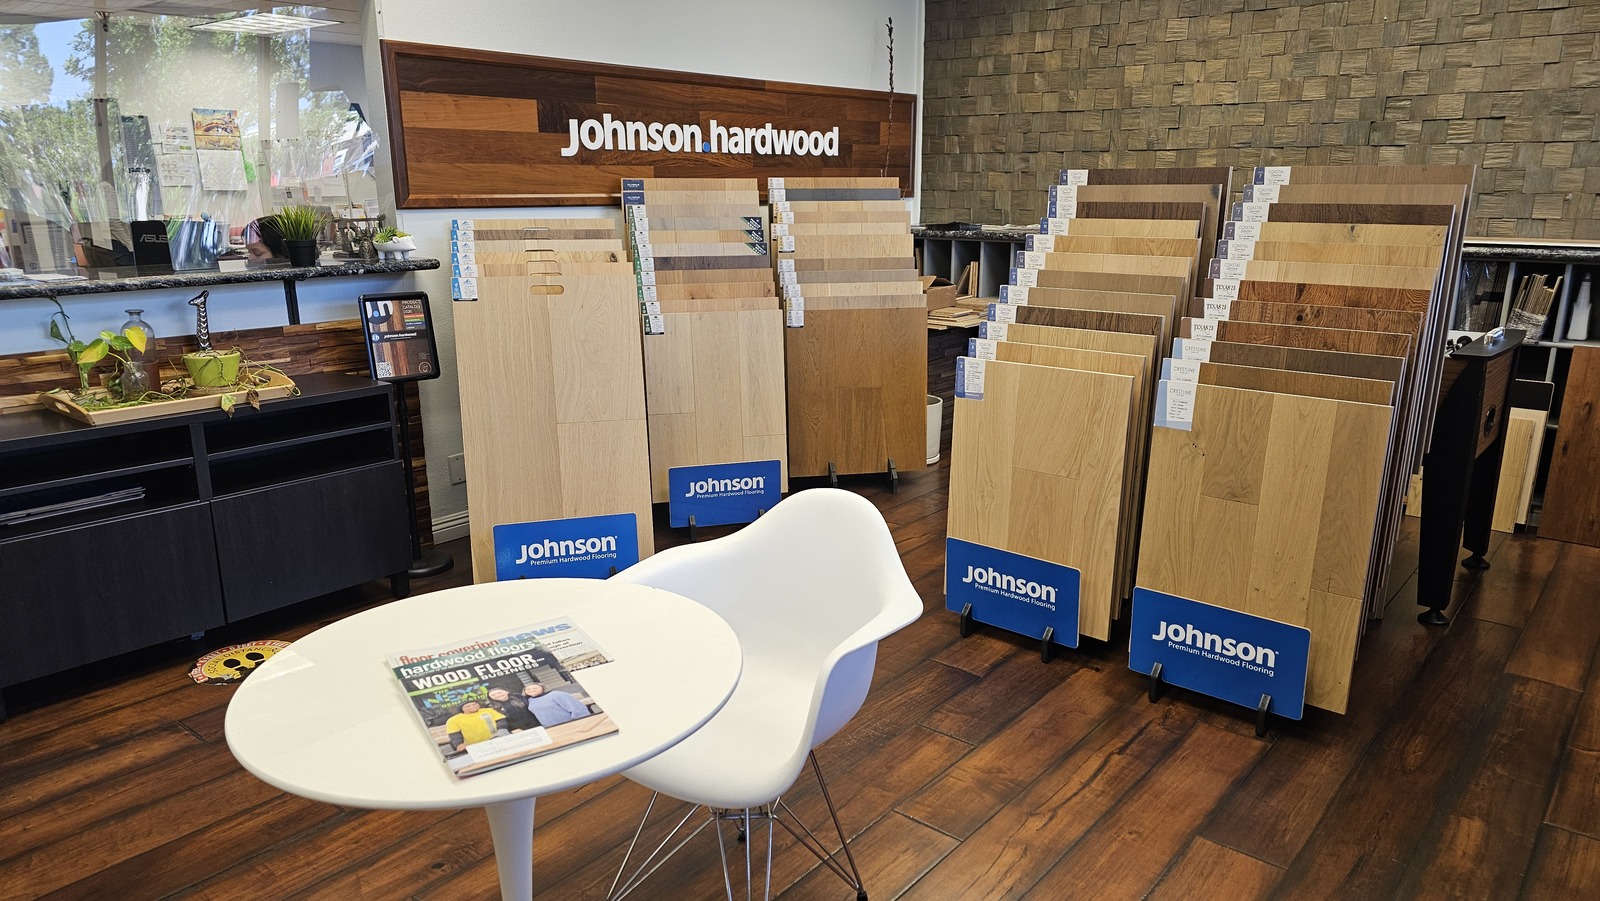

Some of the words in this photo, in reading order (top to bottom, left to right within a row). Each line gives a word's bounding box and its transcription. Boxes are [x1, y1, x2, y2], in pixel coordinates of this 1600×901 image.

[140, 234, 168, 243] ASUS
[560, 554, 590, 563] Hardwood
[975, 583, 1000, 595] Premium
[1000, 588, 1030, 603] Hardwood
[1031, 598, 1056, 611] Flooring
[498, 623, 572, 644] news
[400, 650, 486, 678] hardwood
[488, 640, 536, 657] floors
[481, 663, 539, 680] BUSINESS
[1168, 641, 1200, 655] Premium
[1202, 650, 1240, 667] Hardwood
[1242, 662, 1274, 678] Flooring
[412, 668, 472, 690] WOOD
[474, 654, 537, 677] FLOOR
[422, 683, 490, 708] NEXT
